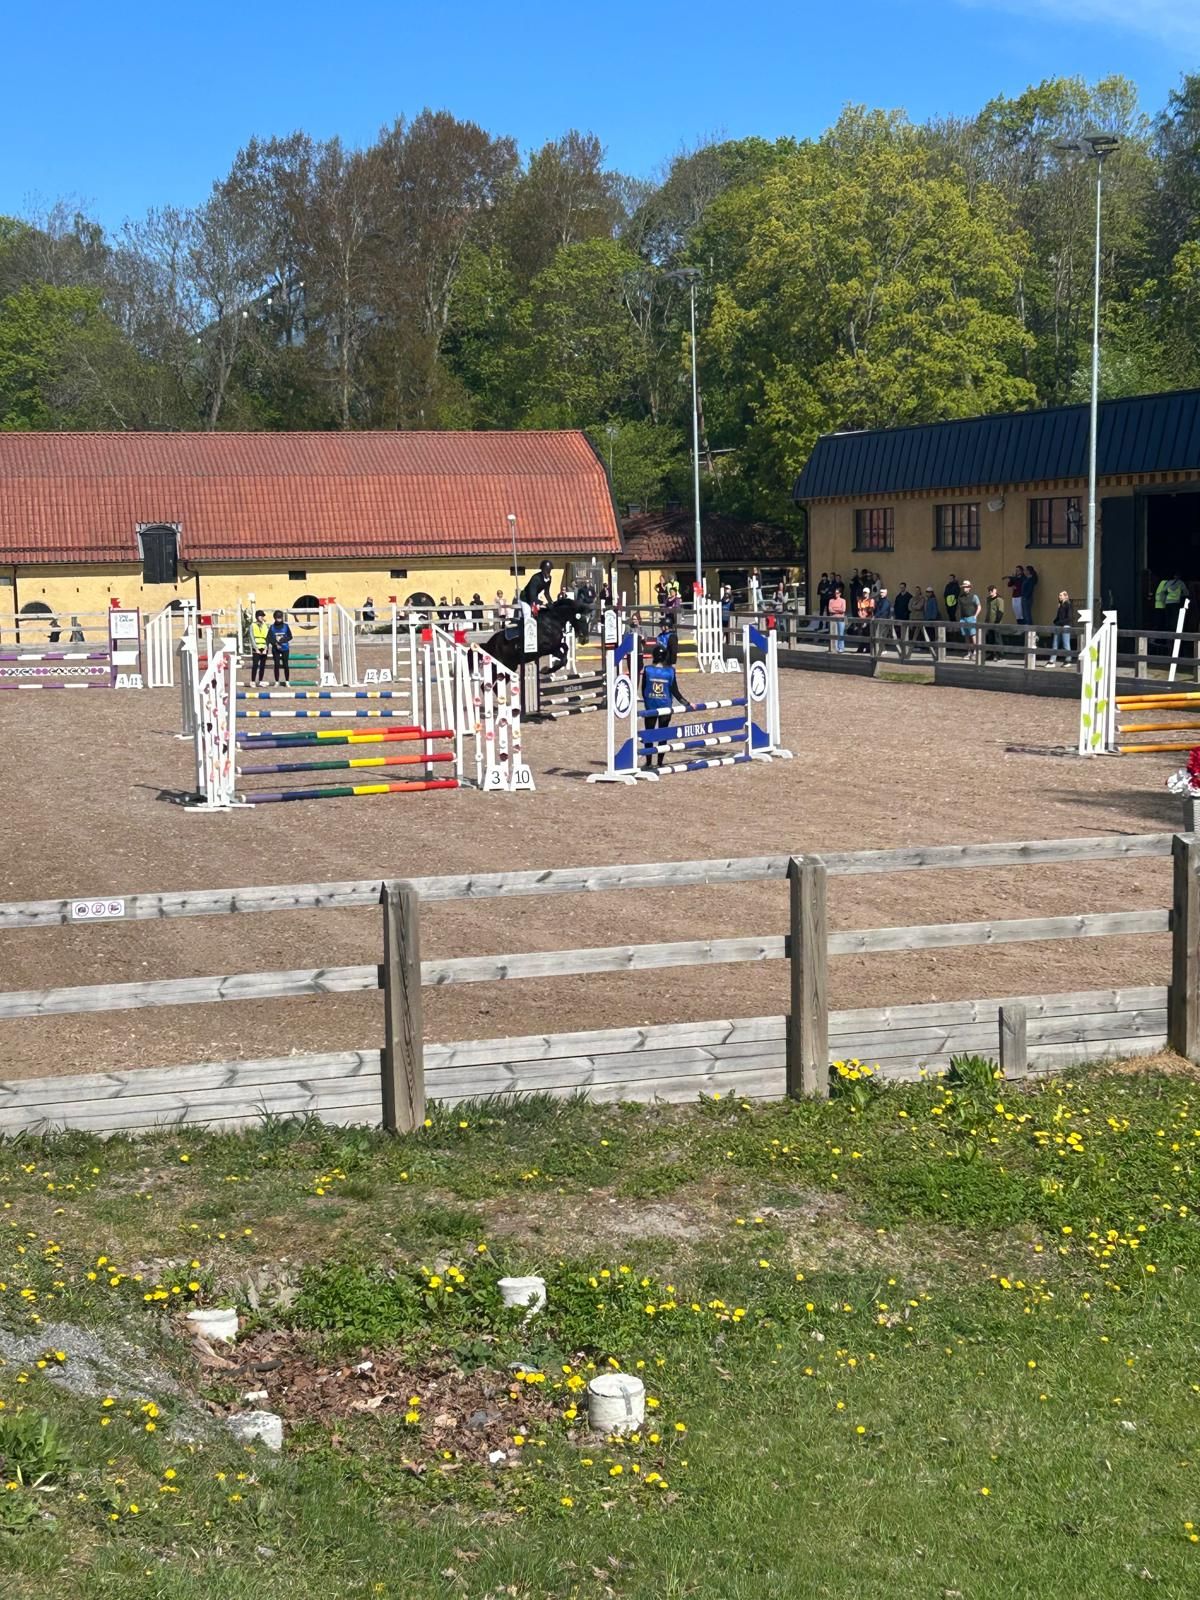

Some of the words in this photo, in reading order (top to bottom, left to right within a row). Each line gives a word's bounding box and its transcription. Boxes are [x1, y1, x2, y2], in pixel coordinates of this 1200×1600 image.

[367, 672, 375, 680] 12
[684, 723, 706, 737] HURK
[491, 770, 501, 785] 3
[515, 769, 530, 784] 10
